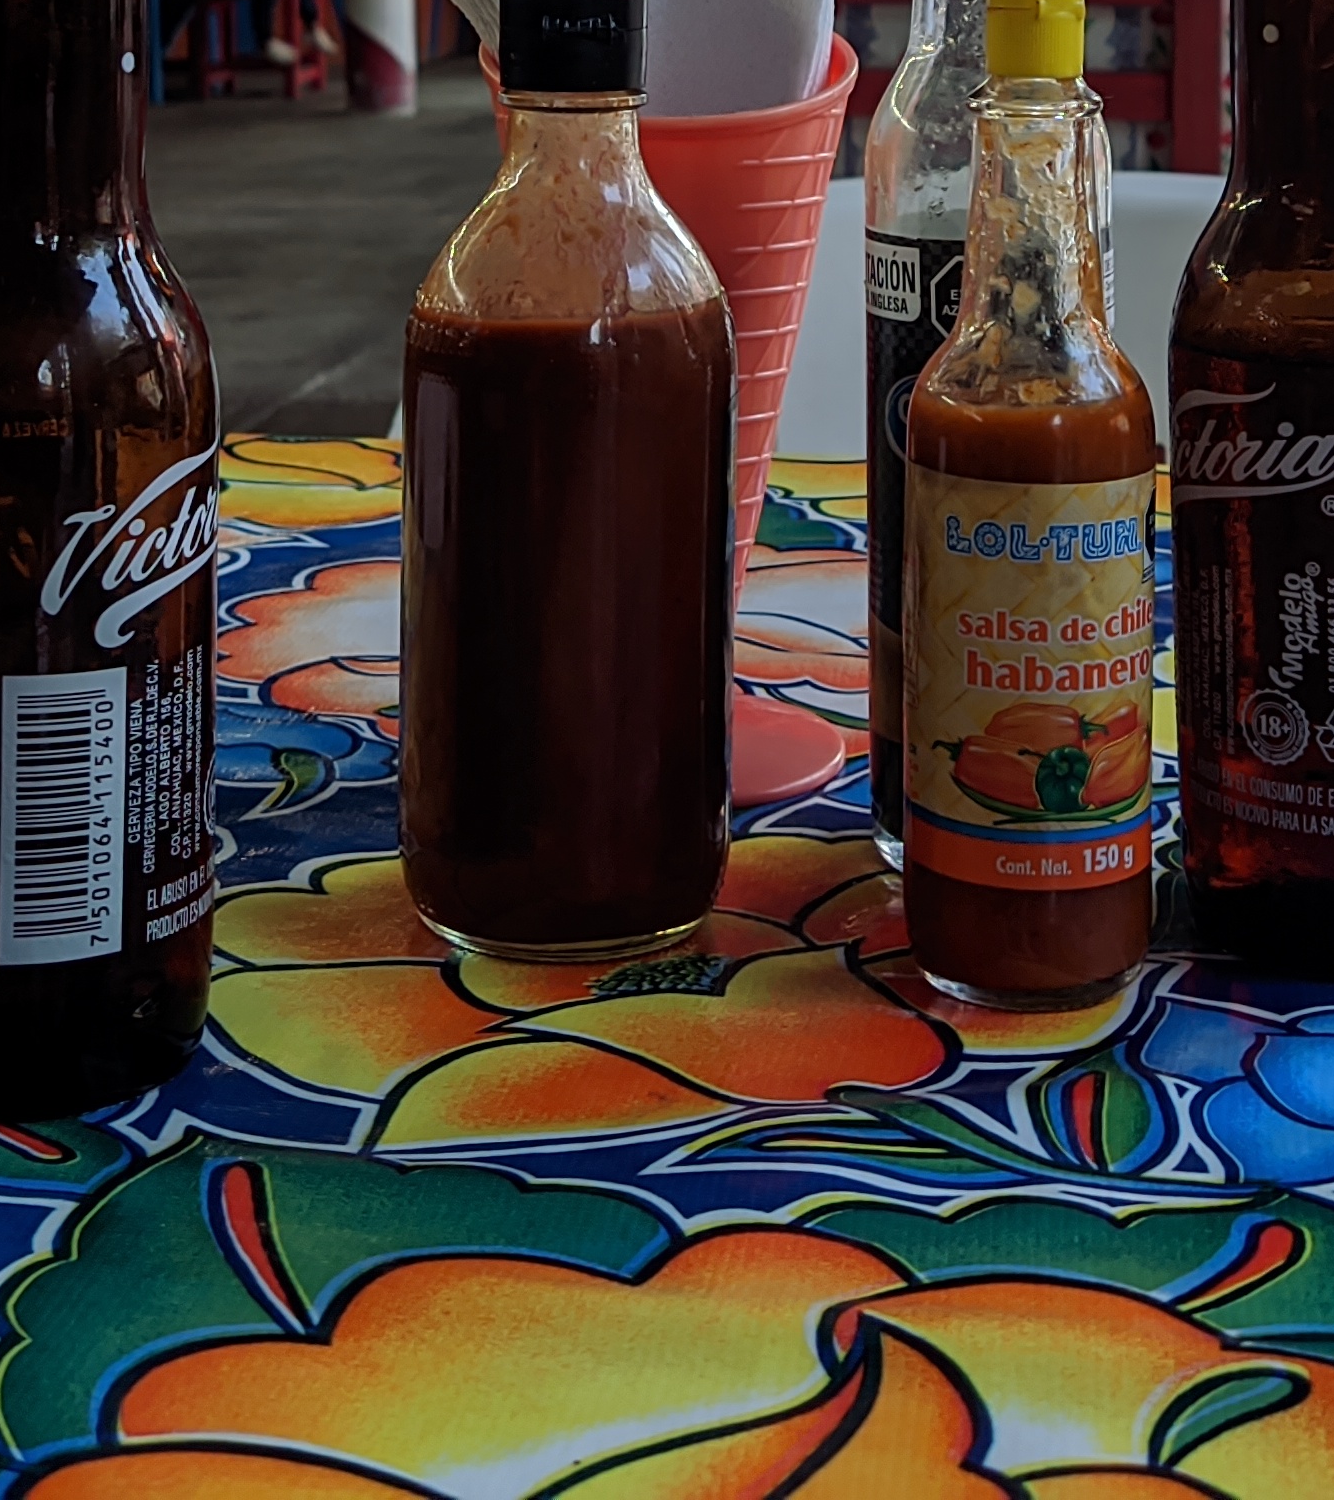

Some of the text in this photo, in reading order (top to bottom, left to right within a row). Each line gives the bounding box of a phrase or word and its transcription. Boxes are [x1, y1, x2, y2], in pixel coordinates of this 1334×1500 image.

[956, 609, 1050, 644] salsa
[1059, 616, 1098, 644] de
[1273, 572, 1304, 685] Modelo
[964, 647, 1151, 693] habanero
[1258, 713, 1292, 739] 18+
[128, 698, 143, 843] CERVEZA TIPO VIENA
[159, 725, 171, 786] ALBERTO
[1250, 776, 1304, 805] CONSUMO
[1307, 787, 1324, 807] DE
[158, 792, 170, 831] LAGO
[1272, 809, 1300, 831] PARA
[1302, 813, 1318, 834] LA
[143, 803, 156, 874] CERVECERIA
[171, 822, 181, 856] COL.
[995, 843, 1135, 877] Cont. Net. 150 g
[147, 888, 159, 911] EL
[160, 876, 187, 907] ABUSO
[90, 934, 110, 947] 7
[146, 906, 189, 943] PRODUCTO
